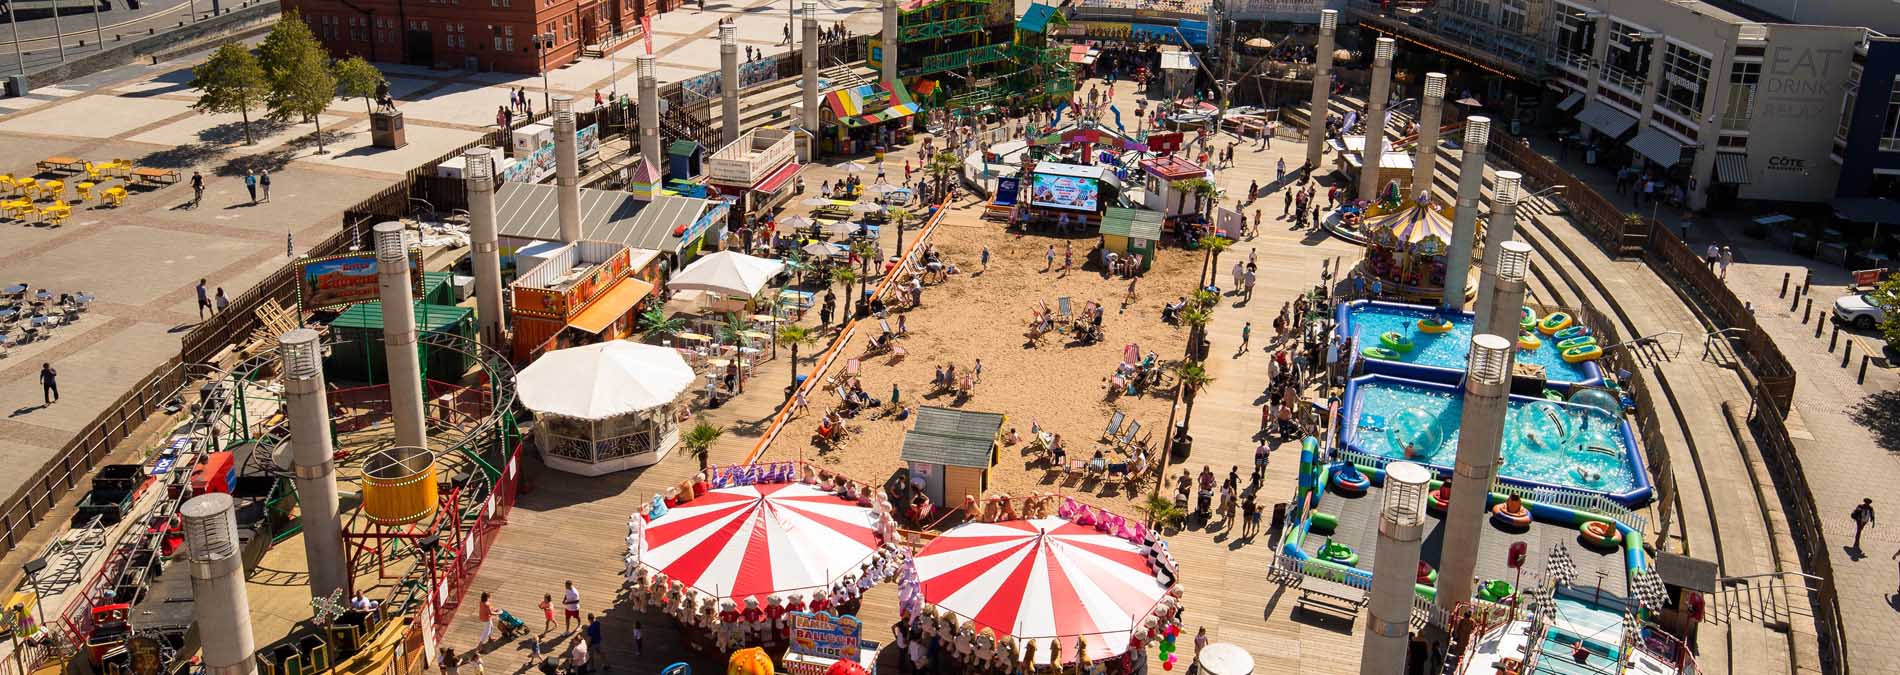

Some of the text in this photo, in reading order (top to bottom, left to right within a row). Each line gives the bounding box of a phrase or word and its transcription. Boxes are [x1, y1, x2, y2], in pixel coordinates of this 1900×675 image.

[1770, 47, 1842, 79] EAT
[1768, 78, 1832, 97] DRINK
[796, 616, 836, 630] FAMILY
[796, 629, 857, 646] BALLOON
[816, 647, 841, 657] RIDE
